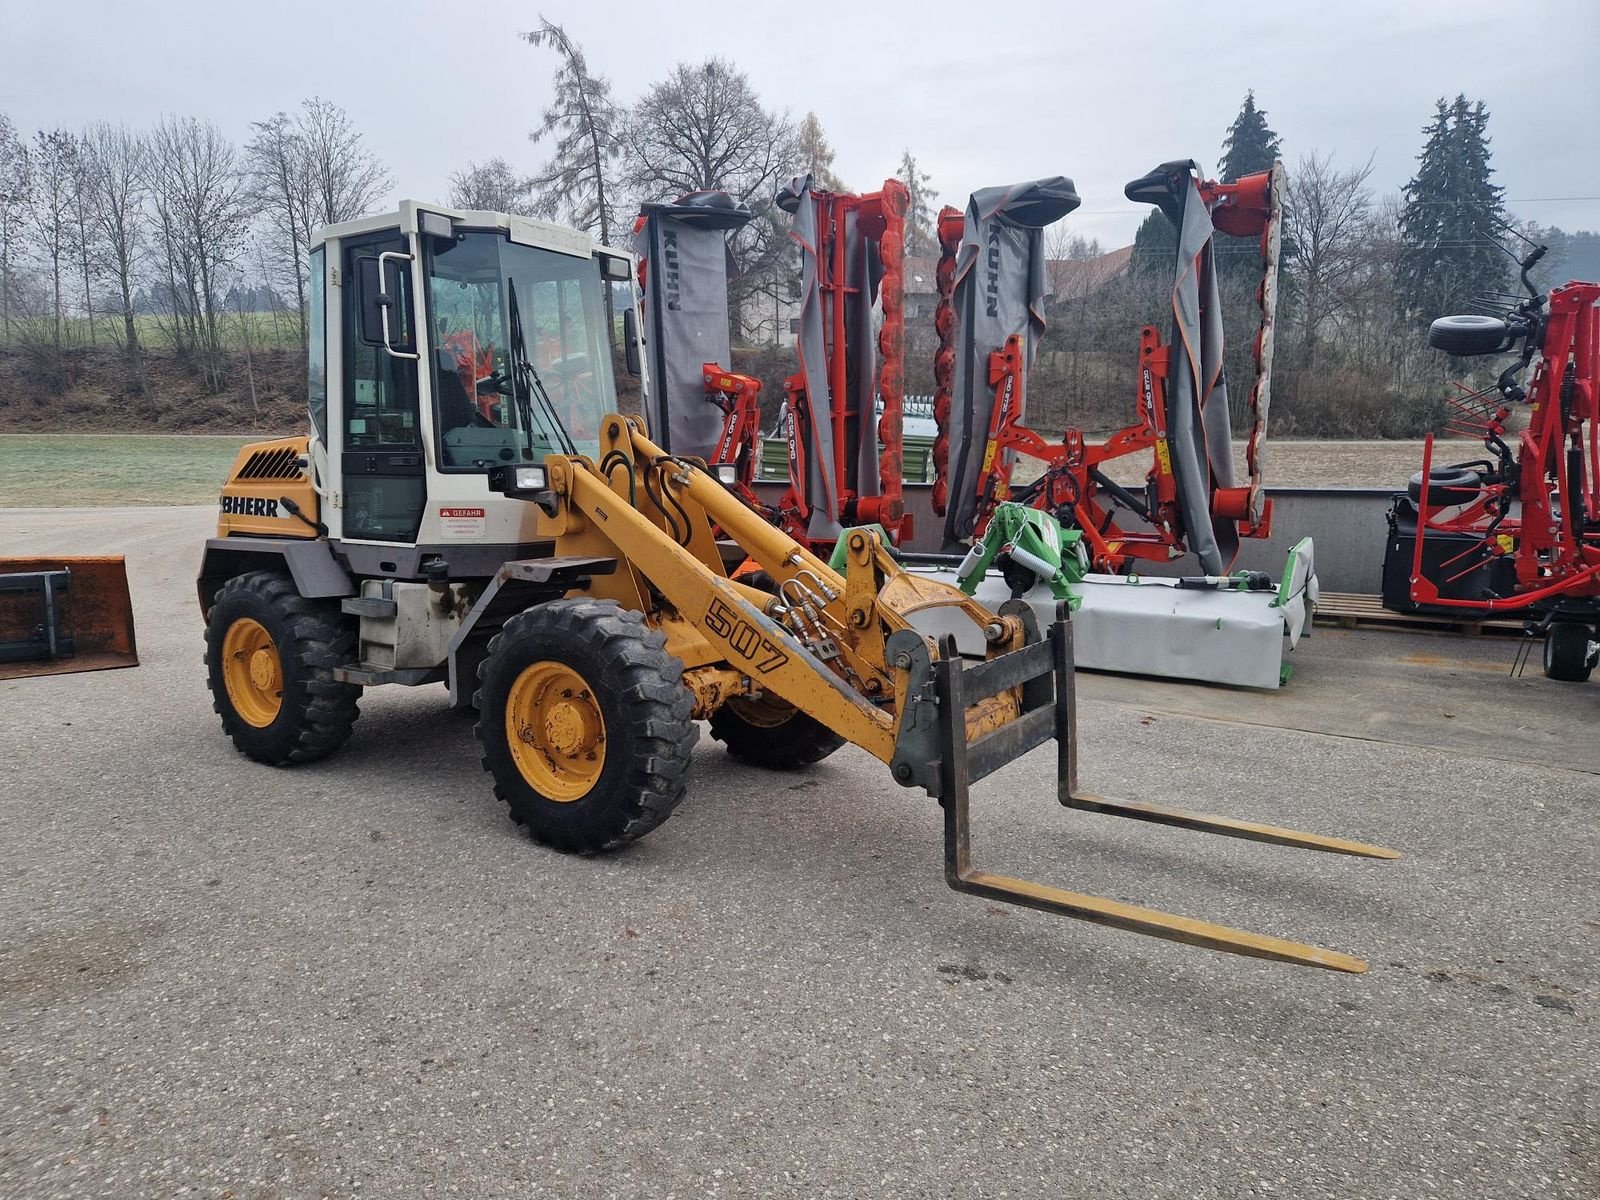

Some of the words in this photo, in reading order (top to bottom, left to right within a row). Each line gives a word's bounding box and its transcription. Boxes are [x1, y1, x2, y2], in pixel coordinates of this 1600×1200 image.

[663, 229, 681, 311] KUHN
[986, 223, 1001, 318] KUHN
[728, 414, 738, 434] GMD
[787, 412, 795, 437] 9530
[720, 436, 731, 460] 9530
[220, 496, 278, 517] BHERR
[452, 509, 481, 517] GEFAHR
[705, 596, 790, 674] 507
